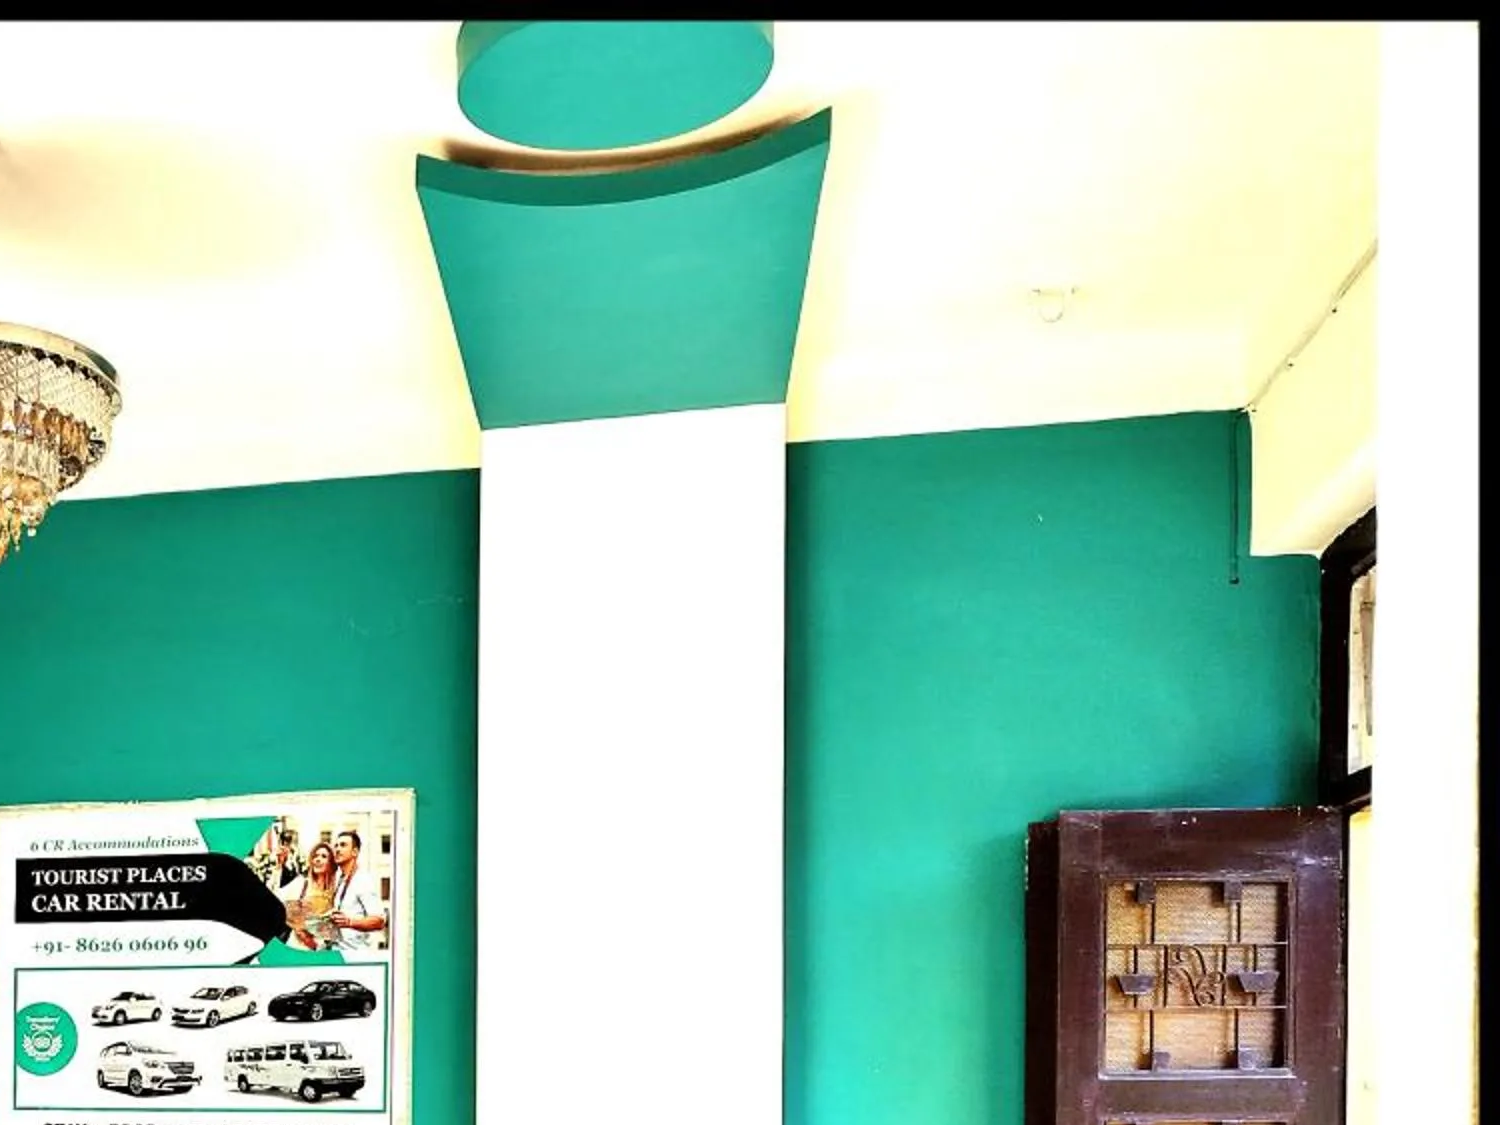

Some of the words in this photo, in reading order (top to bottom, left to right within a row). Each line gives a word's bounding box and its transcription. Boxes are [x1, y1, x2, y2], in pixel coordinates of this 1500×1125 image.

[43, 839, 65, 852] CR
[67, 835, 200, 851] Accommodations
[31, 867, 123, 886] TOURIST
[126, 865, 207, 884] PLACES
[31, 893, 82, 913] CAR
[86, 891, 186, 912] RENTAL
[32, 940, 71, 956] +91-
[75, 937, 123, 953] 8626
[129, 936, 179, 951] 0606
[184, 936, 208, 954] 96
